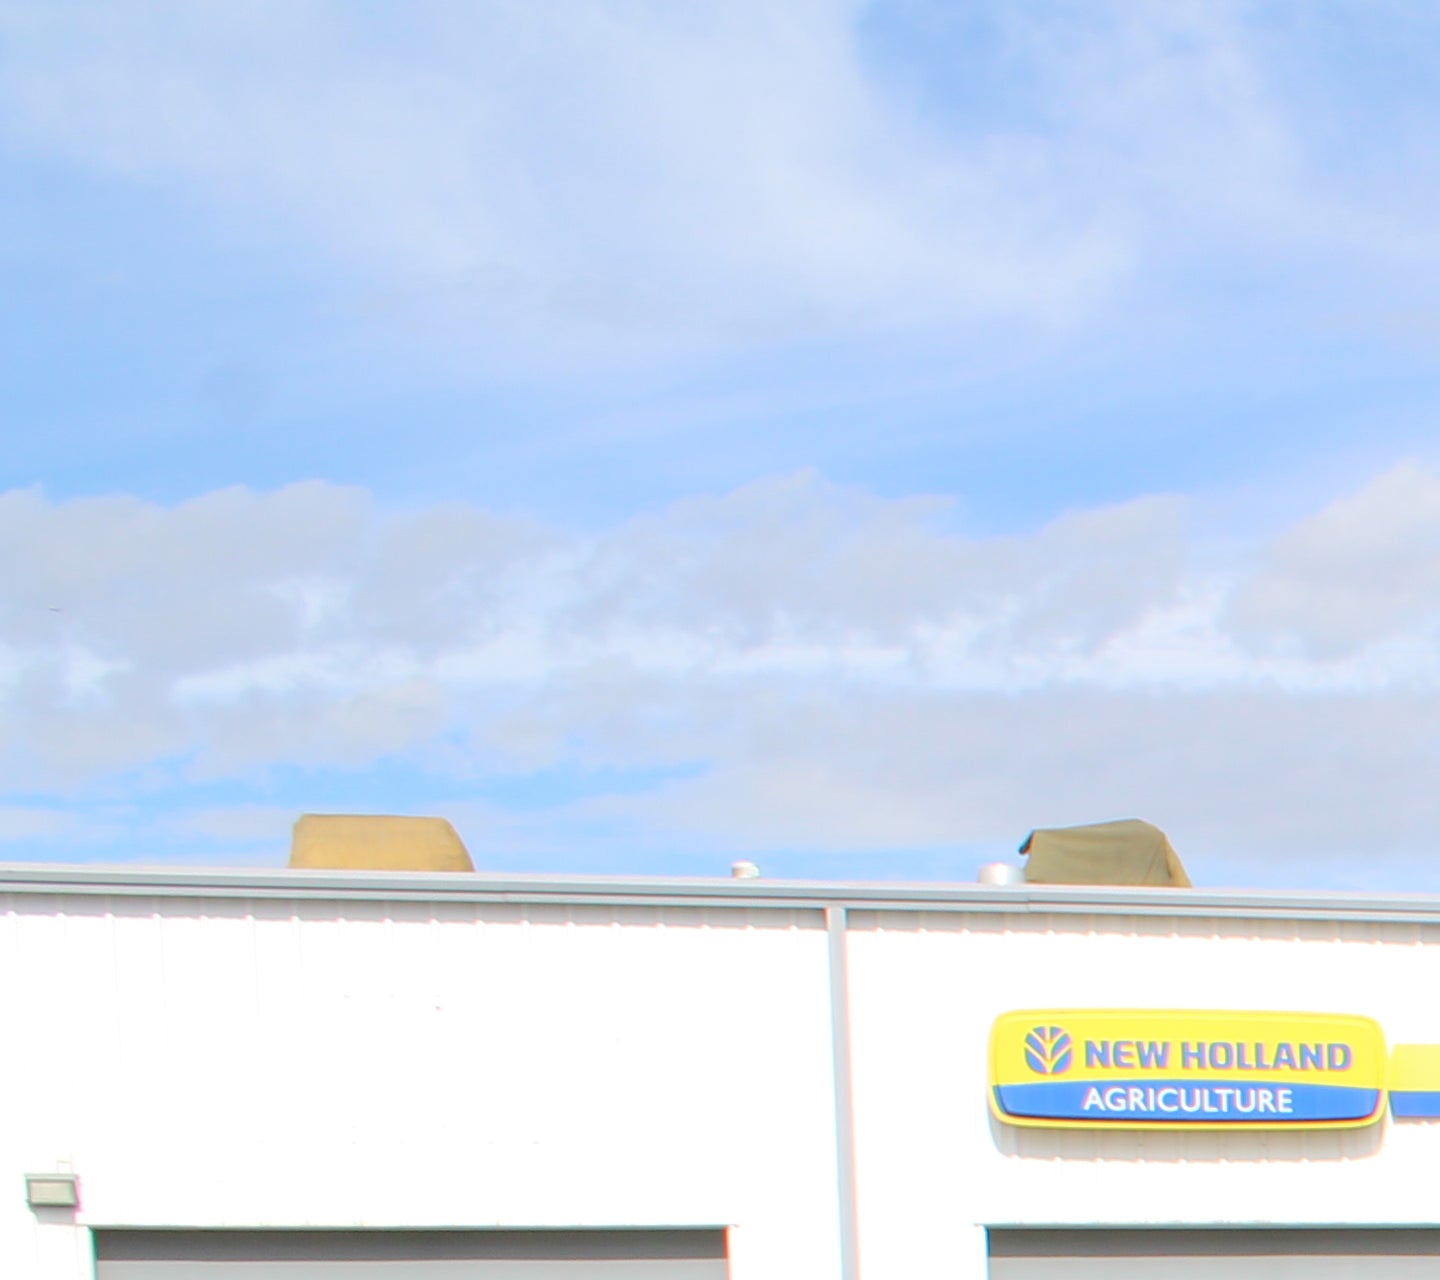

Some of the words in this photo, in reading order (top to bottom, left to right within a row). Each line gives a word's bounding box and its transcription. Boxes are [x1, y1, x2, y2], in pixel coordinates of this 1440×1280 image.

[1085, 1040, 1171, 1069] NEW
[1182, 1042, 1352, 1072] HOLLAND
[1083, 1086, 1294, 1114] AGRICULTURE
